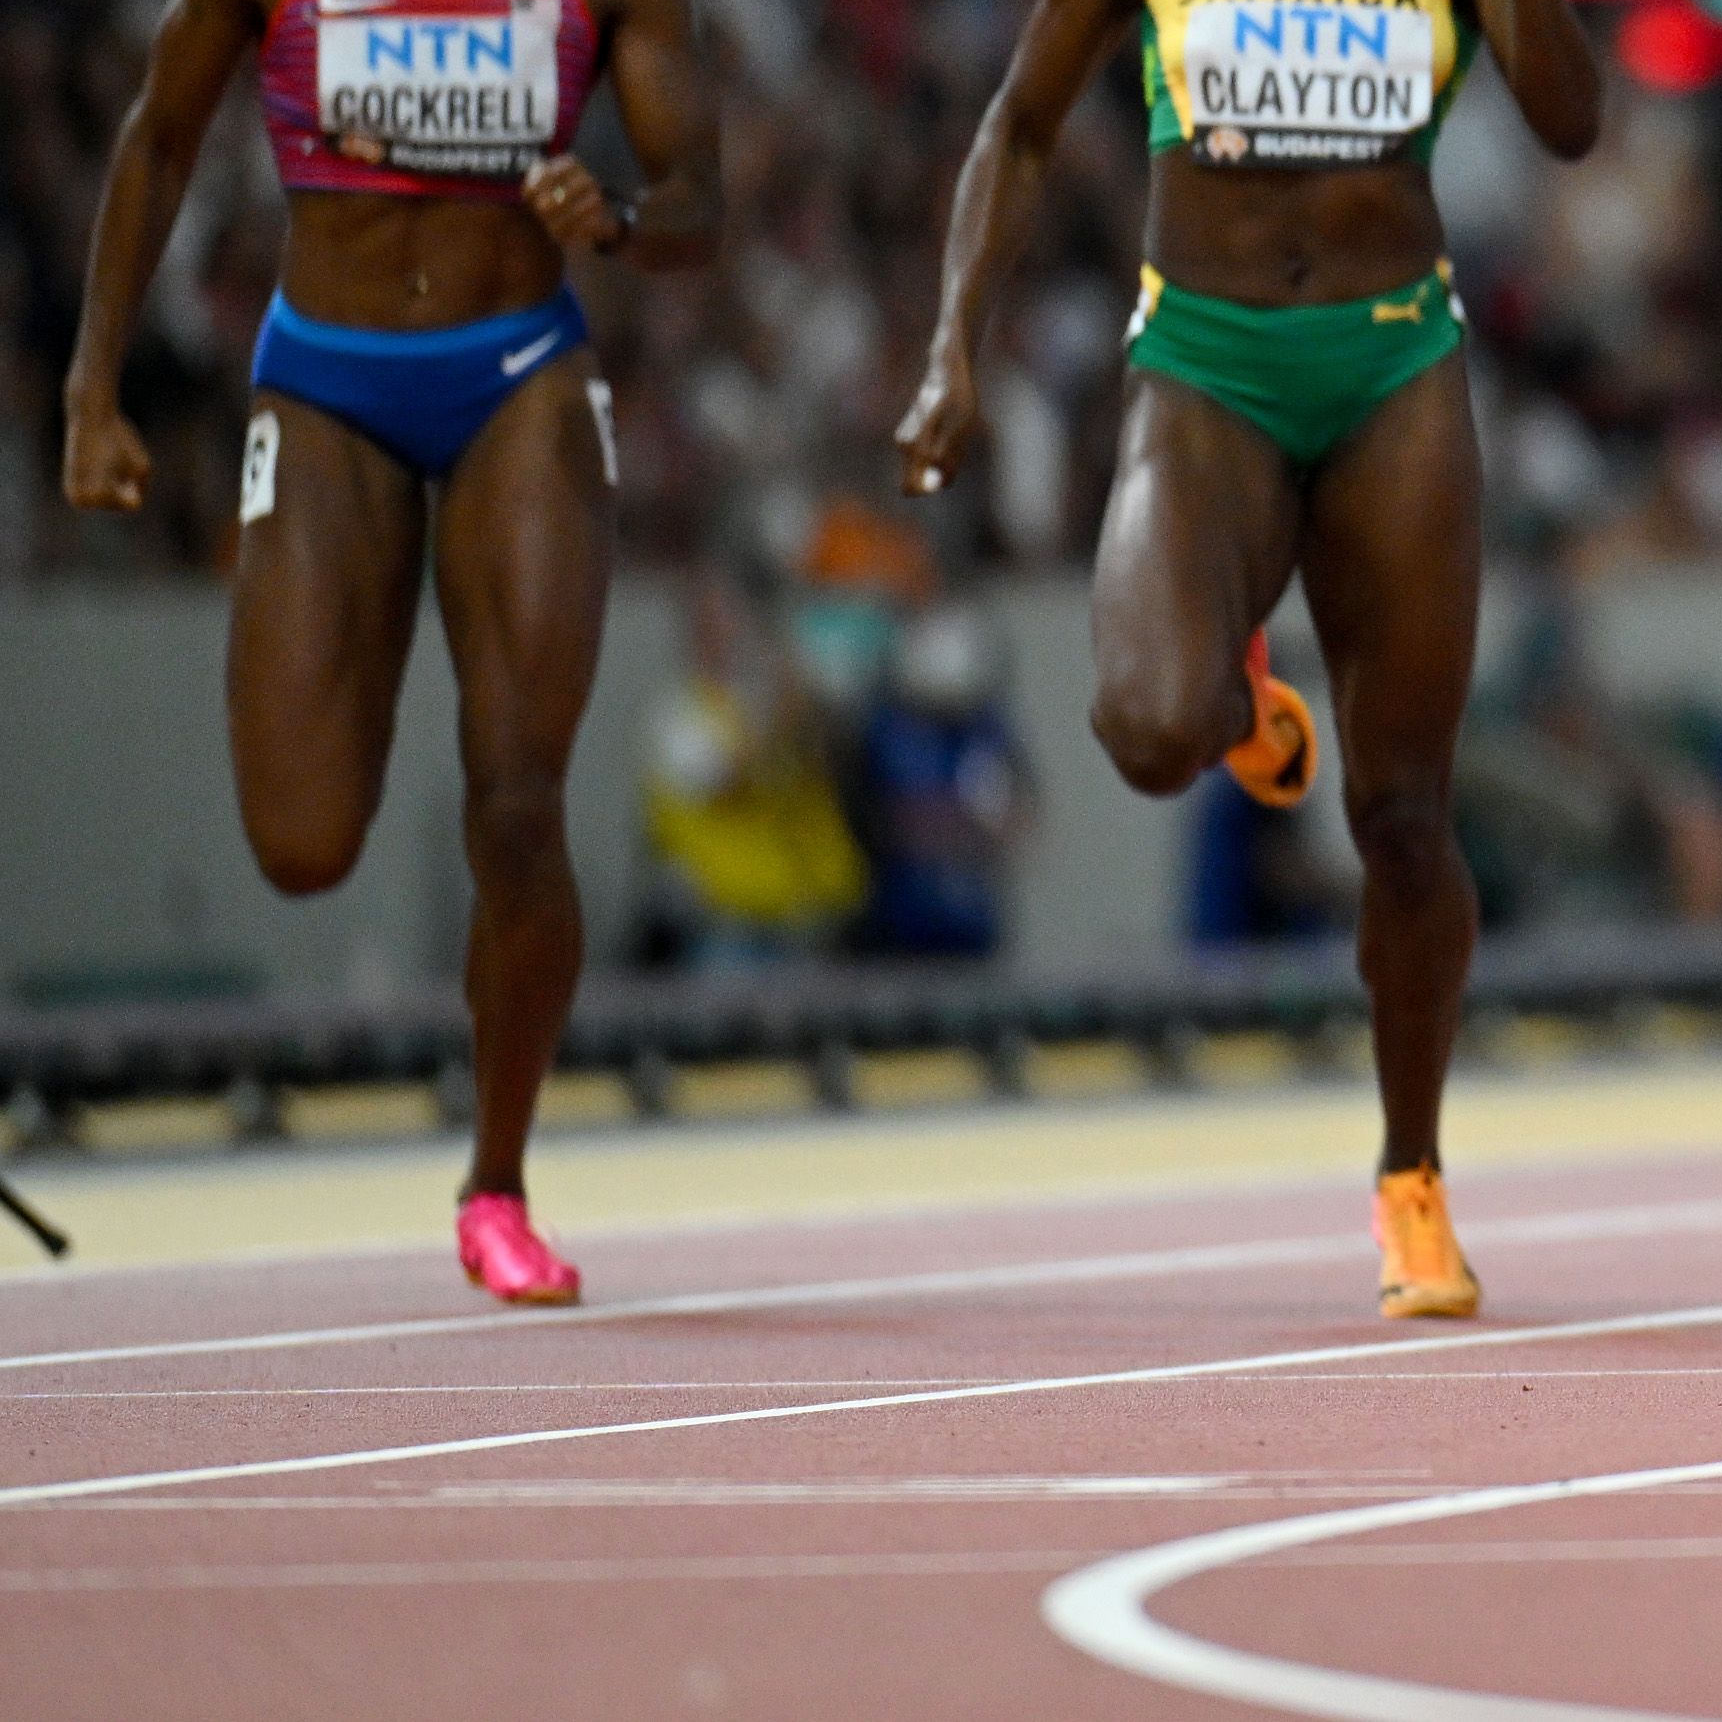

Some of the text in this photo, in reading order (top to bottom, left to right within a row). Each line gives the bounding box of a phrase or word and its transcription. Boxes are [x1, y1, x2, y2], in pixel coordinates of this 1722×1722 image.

[366, 20, 514, 73] NTN
[1234, 6, 1389, 62] NTN
[331, 82, 538, 134] COCKRELL
[1199, 64, 1413, 121] CLAYTON
